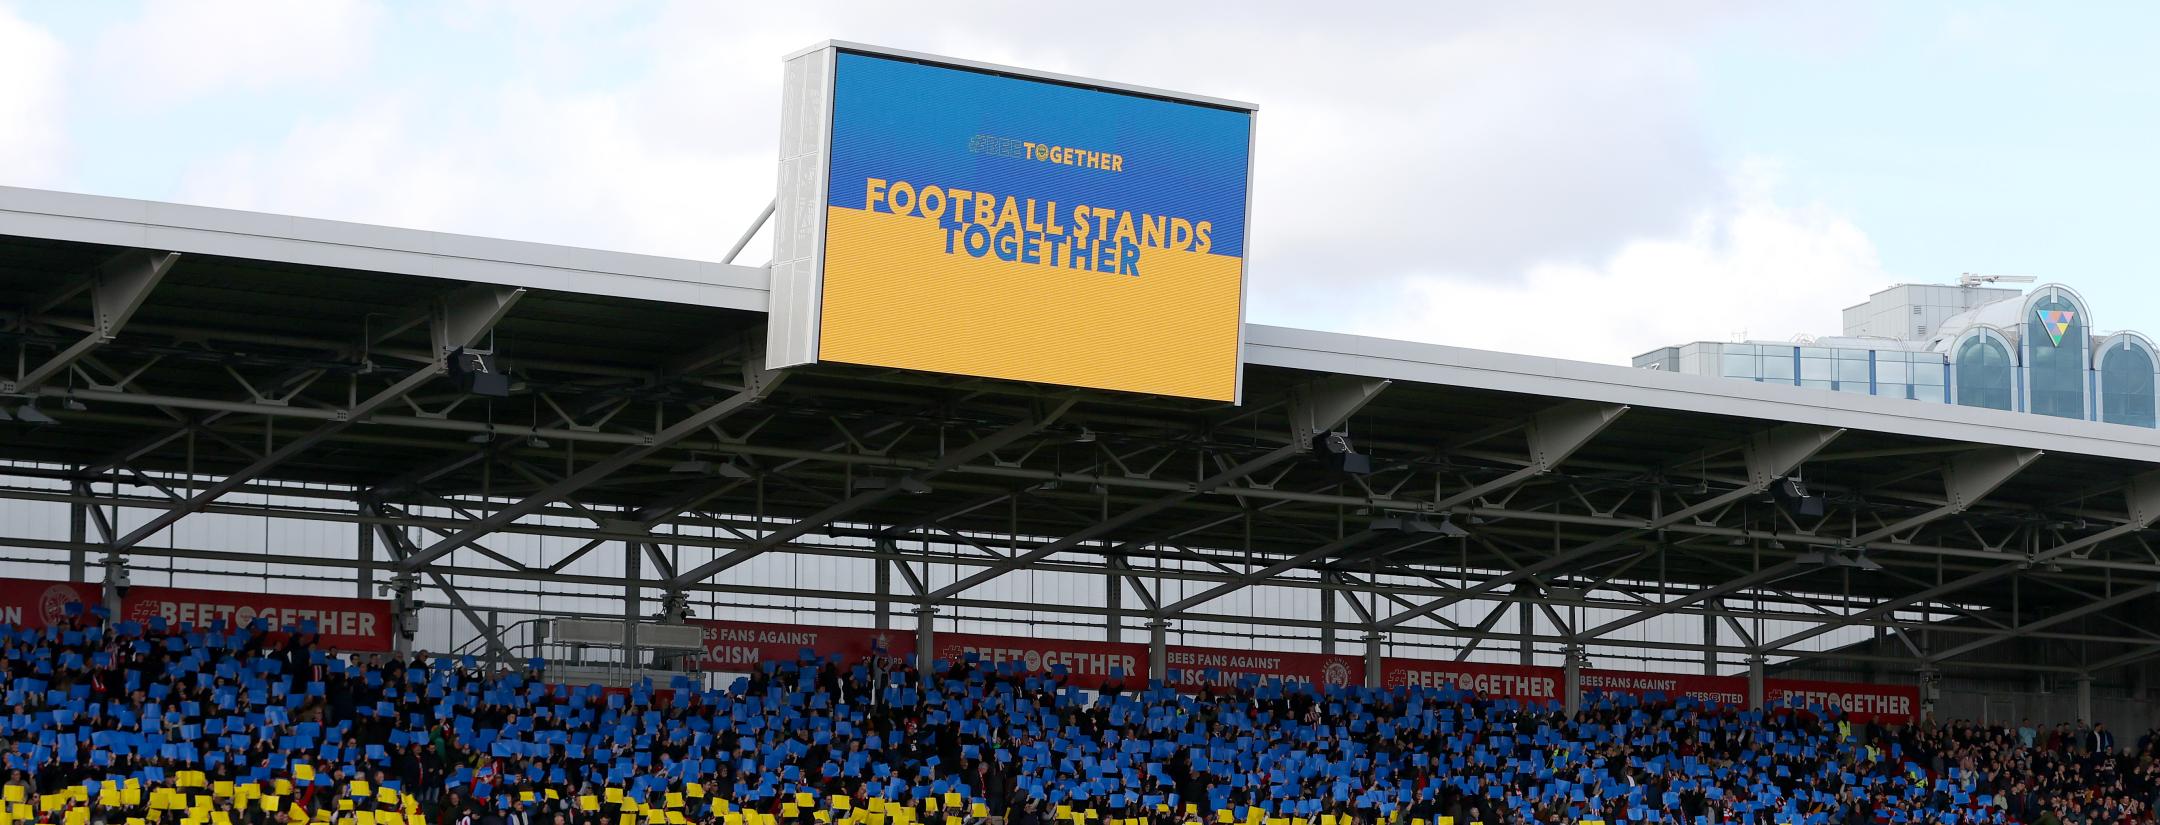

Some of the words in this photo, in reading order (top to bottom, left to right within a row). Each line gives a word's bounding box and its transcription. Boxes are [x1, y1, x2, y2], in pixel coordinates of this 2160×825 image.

[864, 177, 1064, 236] FOOTBALL
[1072, 204, 1213, 255] STANDS
[939, 220, 1141, 277] TOGETHER
[720, 628, 755, 643] FANS
[758, 630, 818, 646] AGAINST
[686, 644, 759, 664] ACISM
[1167, 652, 1195, 666] BEES
[1197, 655, 1228, 668] FANS
[1230, 656, 1281, 670] AGAINST
[1580, 675, 1604, 687] BEES
[1605, 677, 1631, 689] FANS
[1633, 678, 1677, 691] AGAINST
